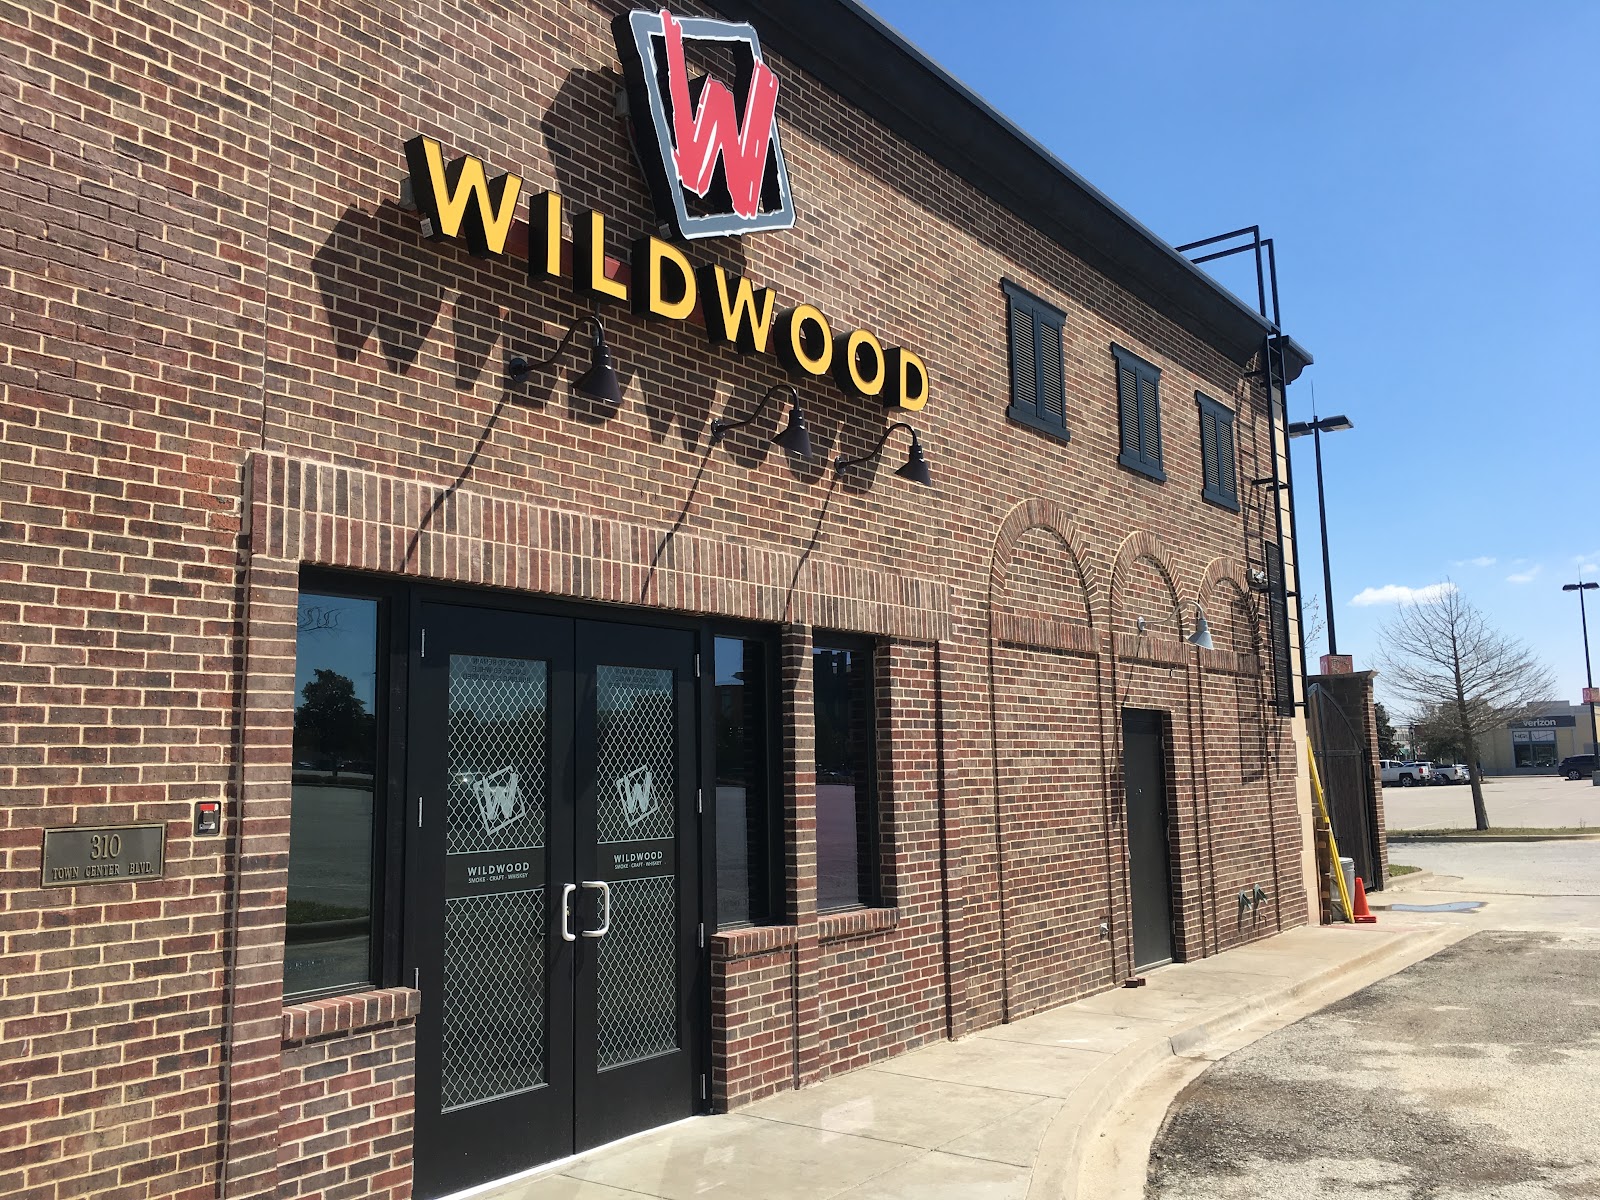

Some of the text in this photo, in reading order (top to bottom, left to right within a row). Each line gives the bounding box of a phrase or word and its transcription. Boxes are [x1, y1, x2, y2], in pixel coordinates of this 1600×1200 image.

[660, 9, 780, 219] W
[420, 134, 930, 412] WILDWOOD
[1523, 719, 1557, 727] verizon
[482, 772, 518, 820] W
[623, 771, 653, 814] W
[90, 833, 122, 860] 310
[614, 851, 663, 863] WILDWOOD
[52, 861, 154, 880] TOWN CENTER BLVD.
[467, 862, 530, 877] WILDWOOD
[468, 872, 529, 884] SMOKE CRAFT WHISKEY
